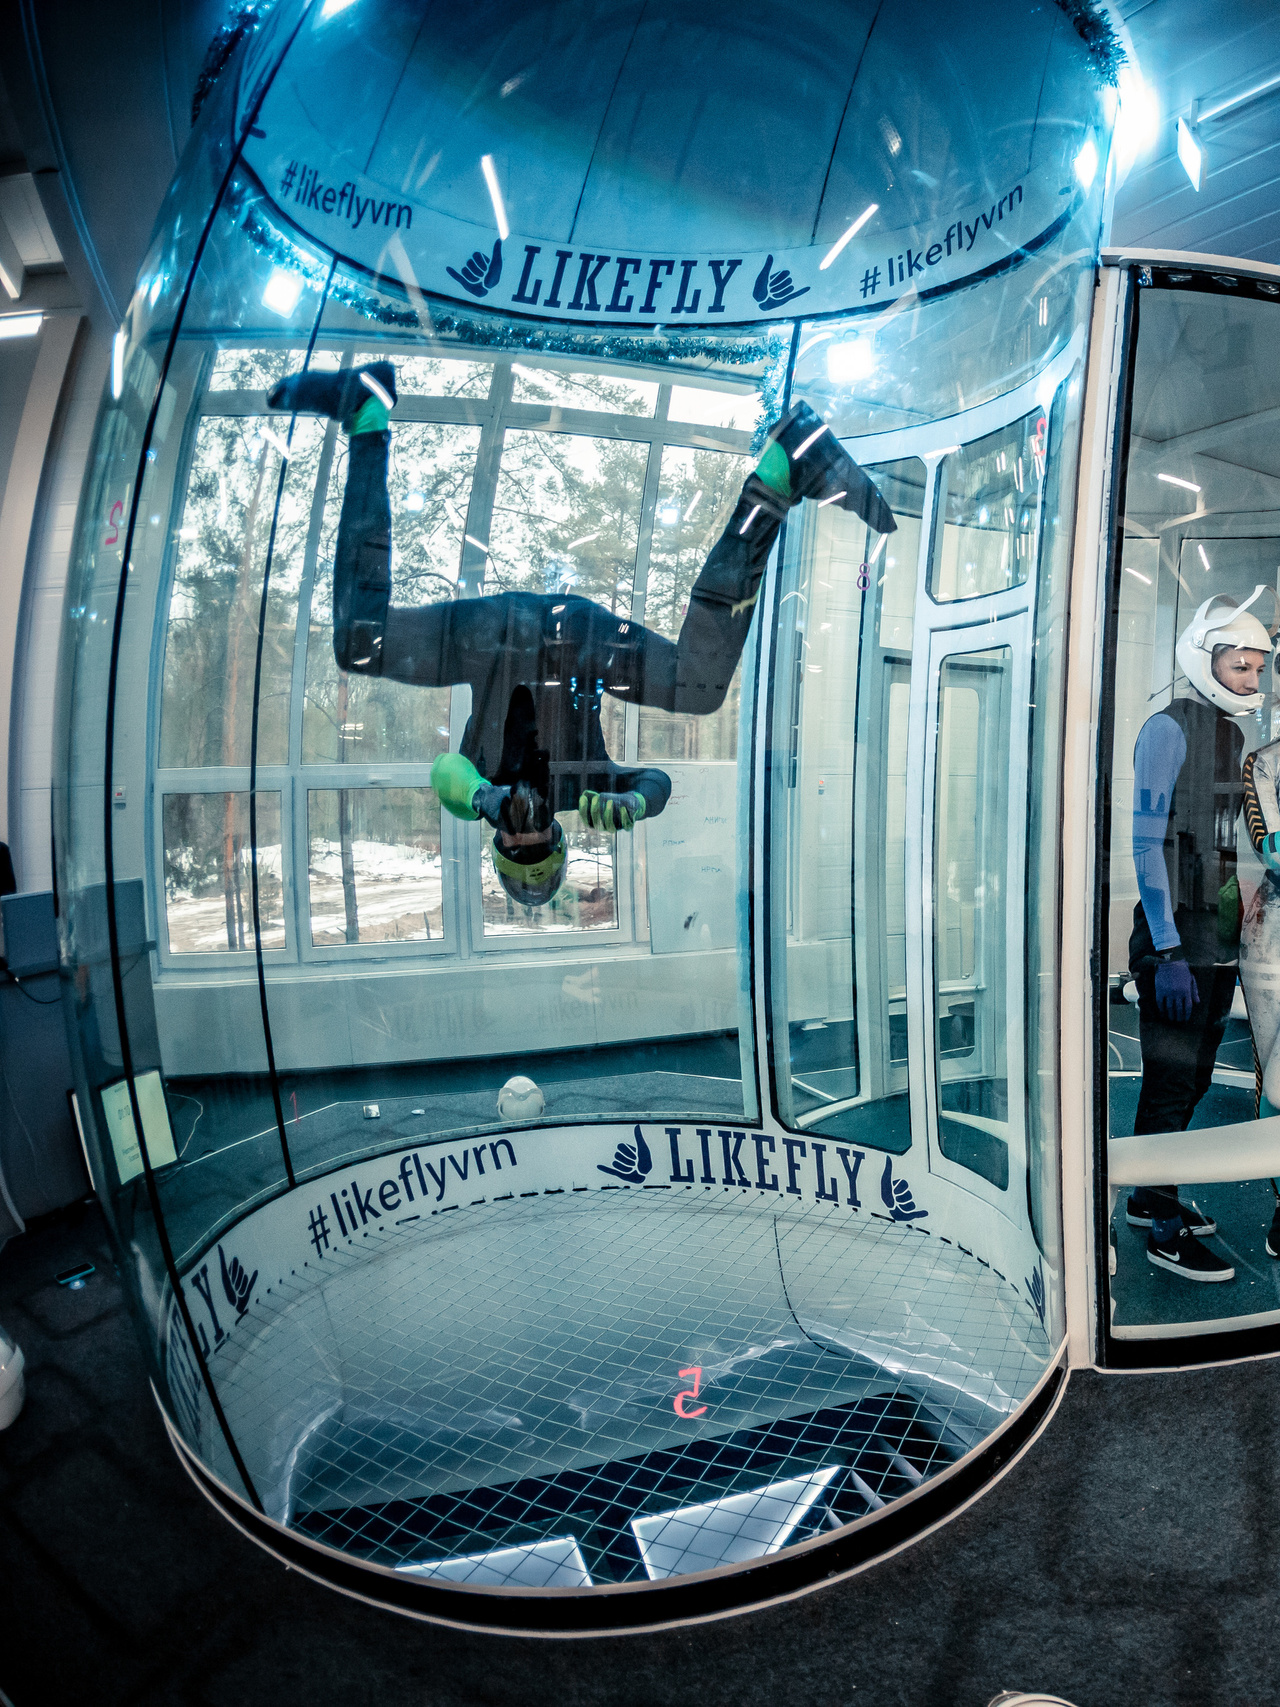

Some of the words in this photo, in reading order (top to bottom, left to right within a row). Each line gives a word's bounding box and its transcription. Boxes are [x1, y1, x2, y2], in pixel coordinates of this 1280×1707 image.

[281, 160, 414, 231] #likeflyvrn
[859, 182, 1024, 299] #likeflyvrn
[511, 244, 743, 314] LIKEFLY
[856, 562, 871, 591] 8
[308, 1135, 519, 1251] #likeflyvrn
[668, 1126, 867, 1208] LIKEFLY
